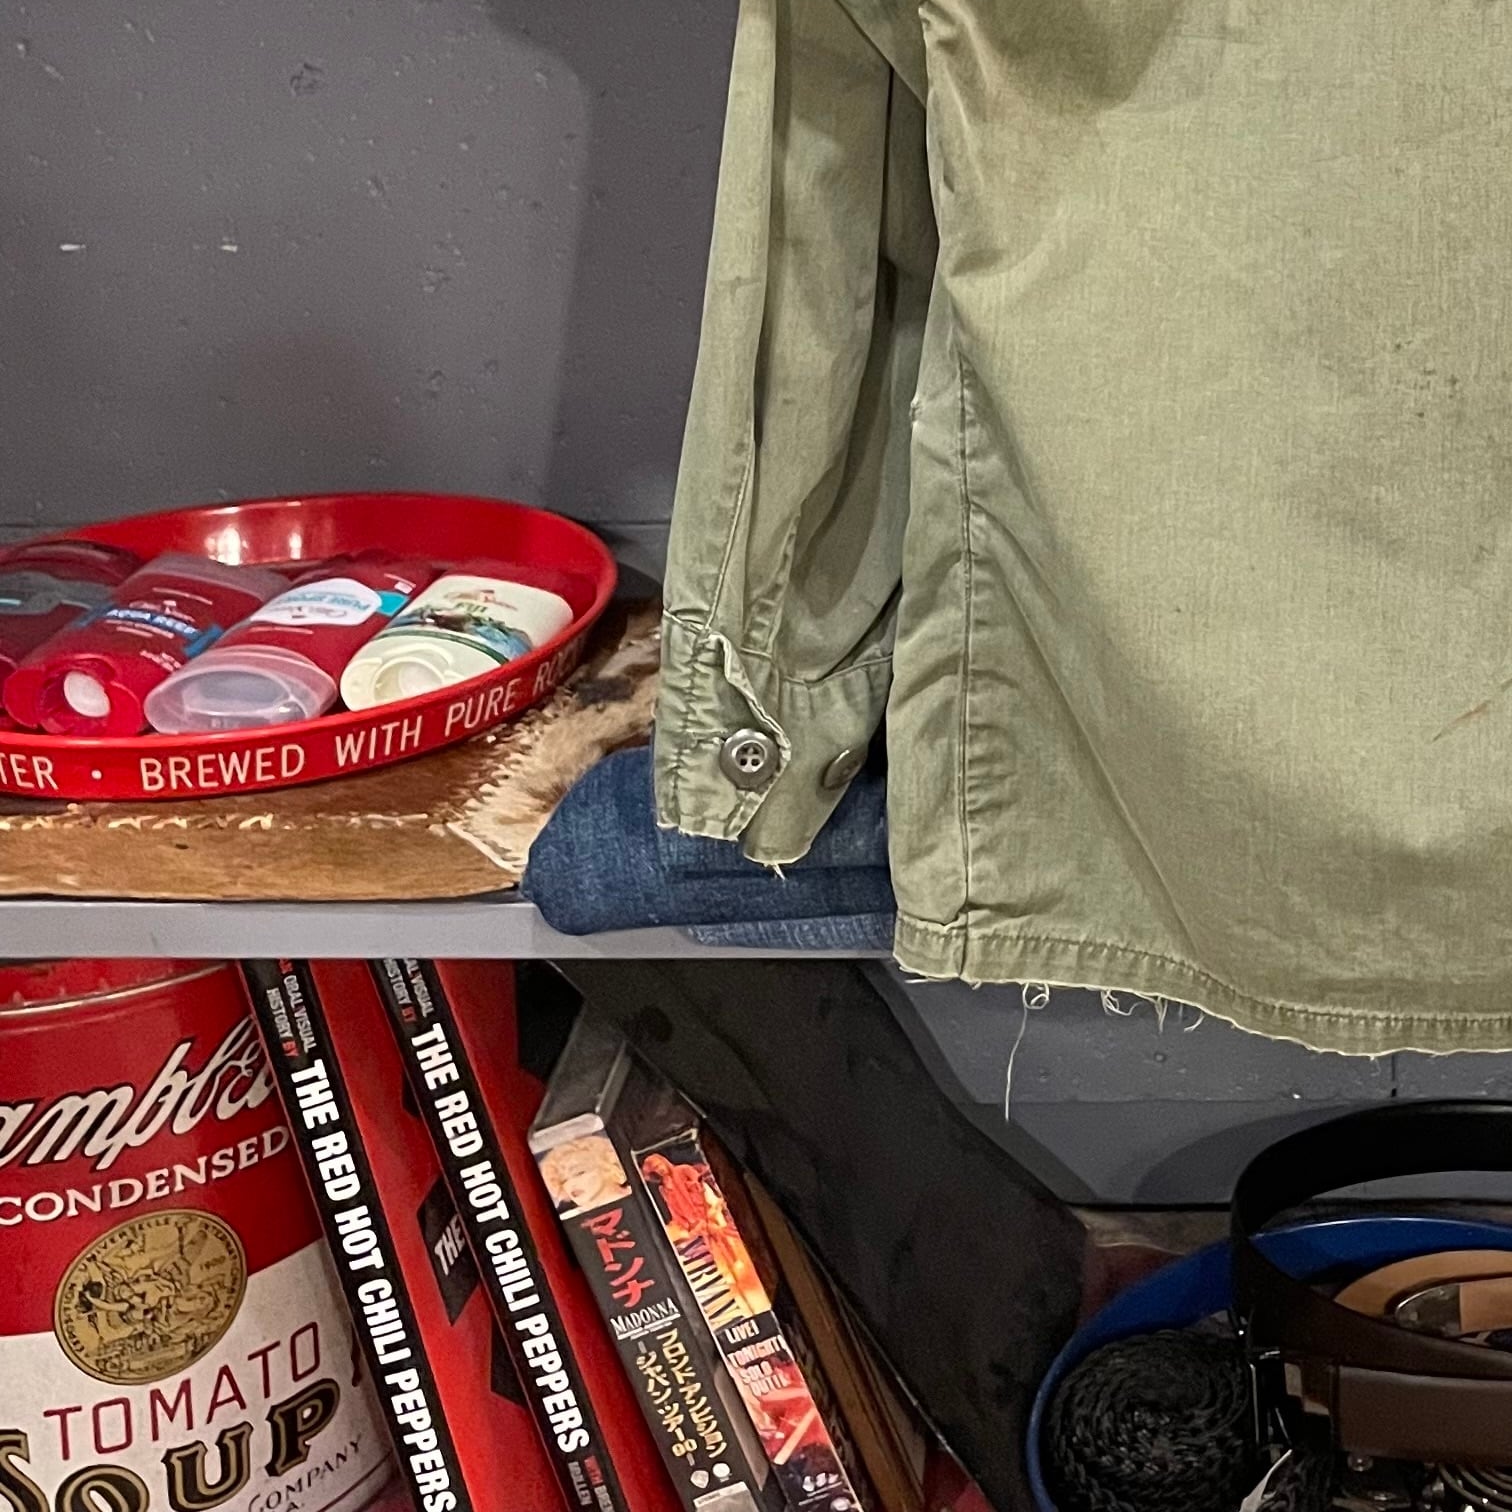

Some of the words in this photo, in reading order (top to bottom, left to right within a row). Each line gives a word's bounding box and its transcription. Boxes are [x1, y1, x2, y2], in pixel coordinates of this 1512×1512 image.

[0, 752, 59, 790] TER
[140, 744, 305, 791] BREWED
[335, 715, 423, 767] WITH
[444, 677, 522, 737] PURE
[266, 987, 294, 1039] HISTORY
[293, 1005, 318, 1054] VISUAL
[412, 1023, 460, 1090] THE
[291, 1059, 340, 1130] THE
[435, 1091, 483, 1157] RED
[0, 1125, 291, 1226] CONDENSED
[312, 1131, 361, 1201] RED
[460, 1161, 510, 1223] HOT
[335, 1206, 385, 1271] HOT
[434, 1214, 465, 1276] THE
[486, 1230, 540, 1312] CHILI
[580, 1207, 655, 1308] マドンナ
[358, 1279, 412, 1365] CHILI
[610, 1296, 680, 1335] MADONNA
[43, 1321, 322, 1461] TOMATO
[516, 1314, 590, 1453] PEPPERS
[0, 1377, 342, 1512] SOUP
[248, 1432, 363, 1512] COMPANY
[385, 1368, 458, 1512] PEPPERS
